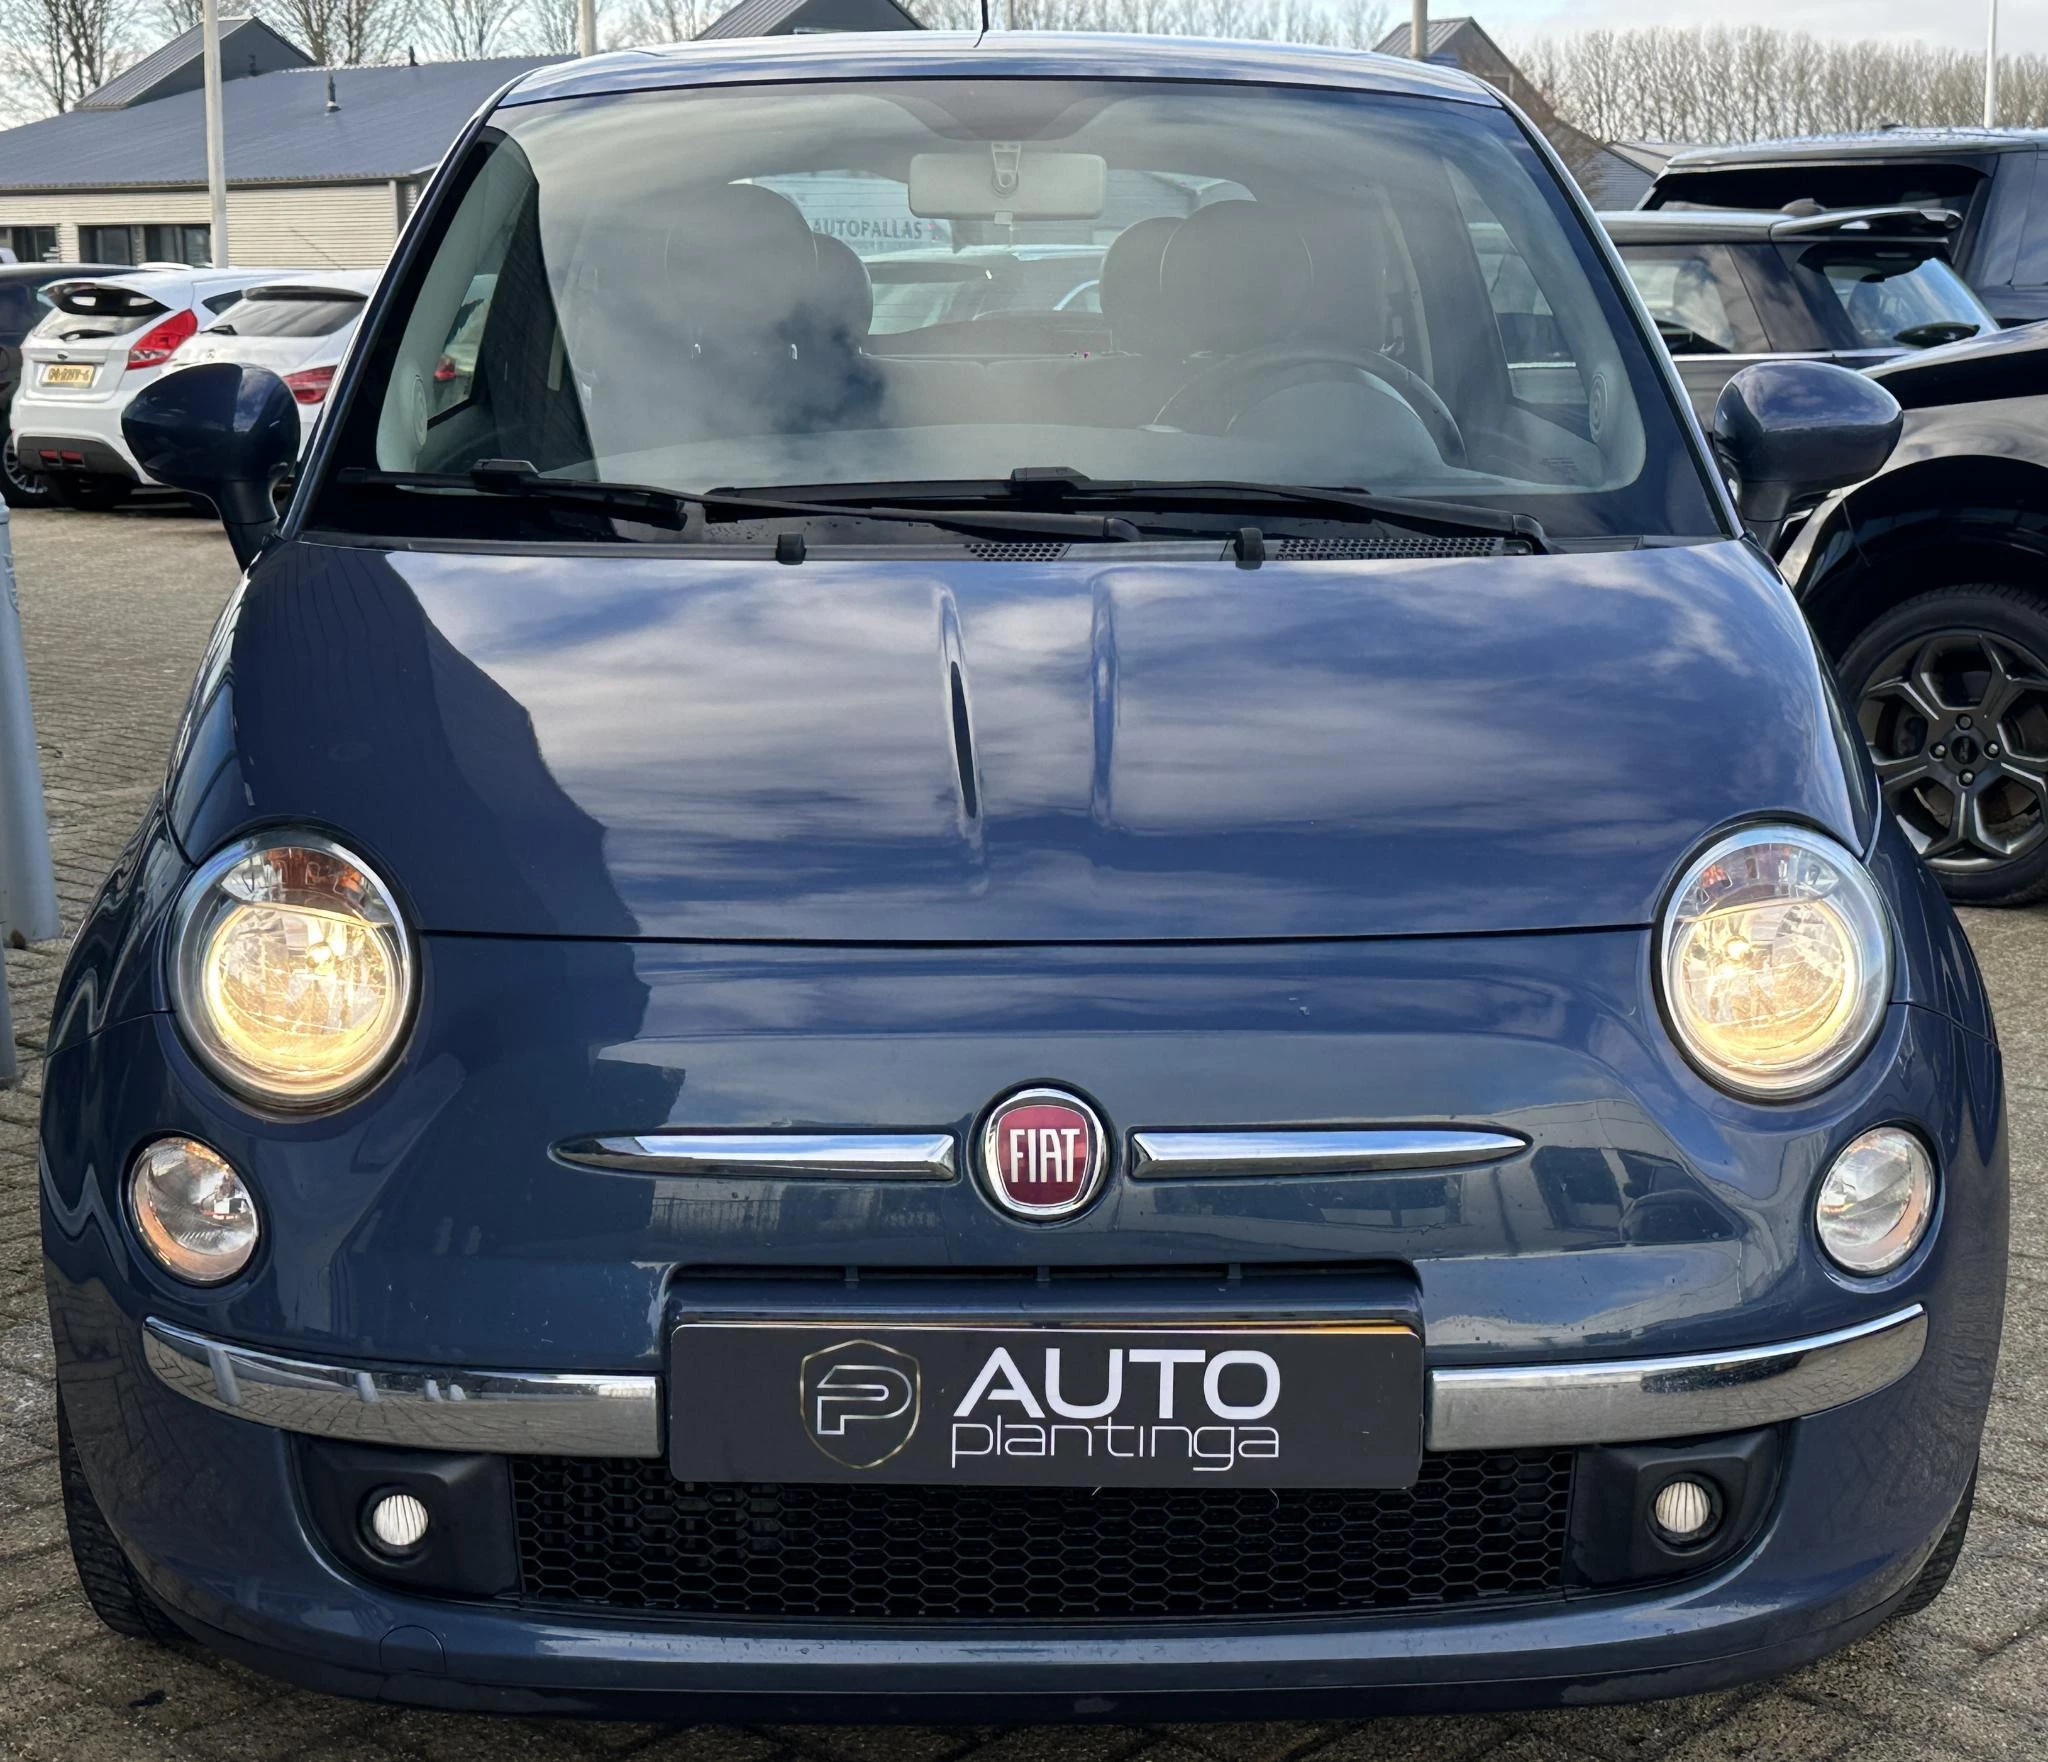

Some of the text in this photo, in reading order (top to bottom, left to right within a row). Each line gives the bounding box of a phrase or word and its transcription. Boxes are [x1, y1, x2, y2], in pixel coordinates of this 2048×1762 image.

[1009, 1128, 1081, 1183] FIAT
[952, 1346, 1281, 1420] AUTO
[951, 1415, 1280, 1472] plantinga
